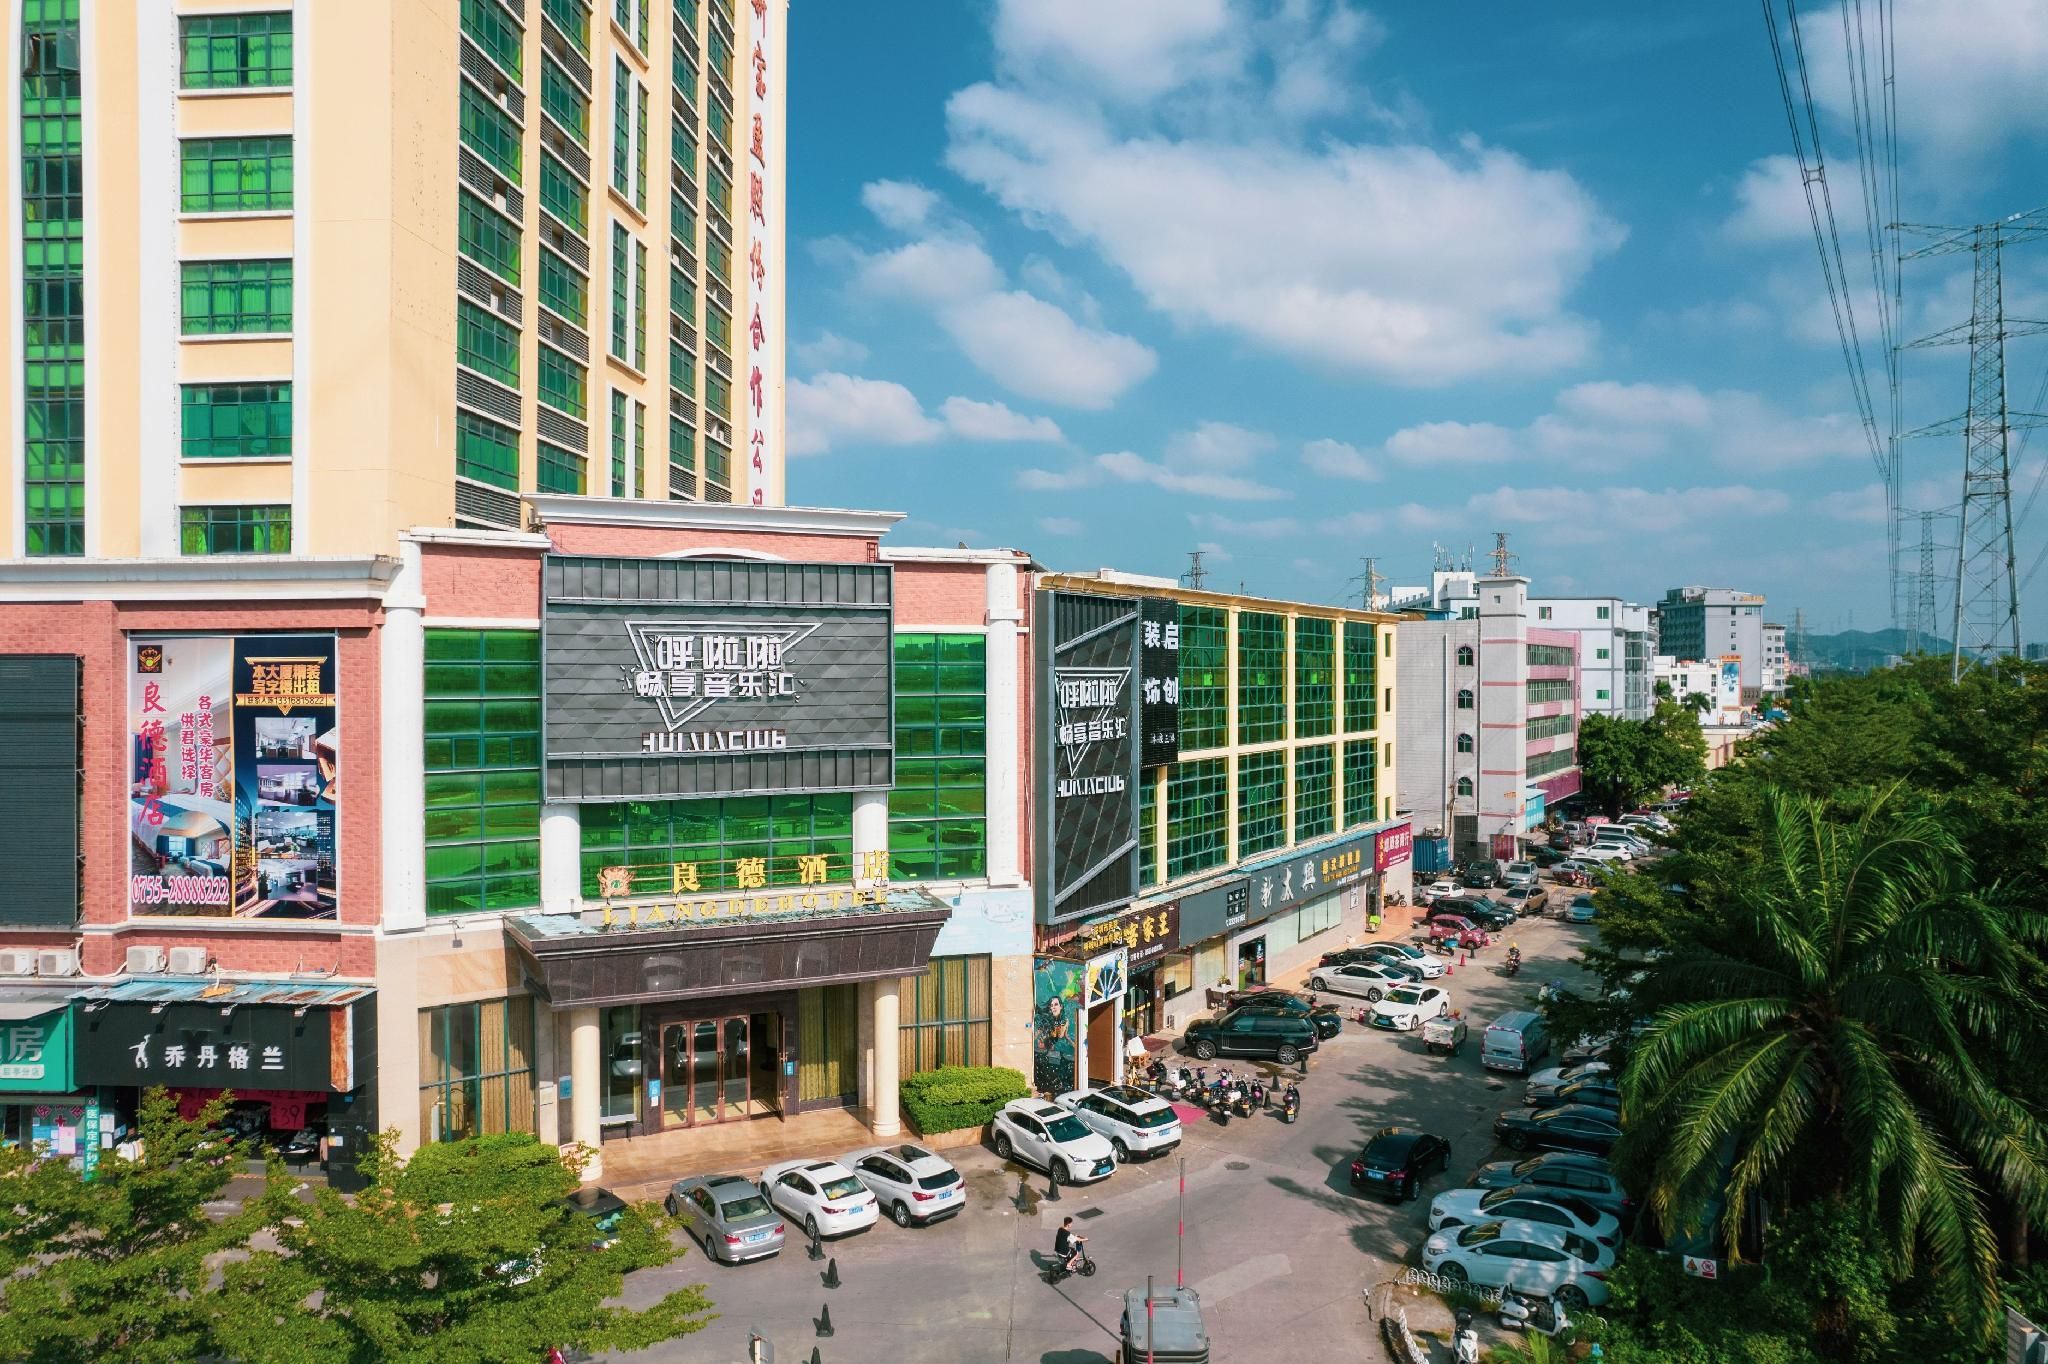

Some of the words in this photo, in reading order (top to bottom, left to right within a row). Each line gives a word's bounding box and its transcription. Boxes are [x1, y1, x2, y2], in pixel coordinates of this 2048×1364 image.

[139, 681, 168, 825] 良德酒店
[132, 875, 229, 904] 0755-28888222
[672, 850, 890, 895] 良德酒店
[0, 1026, 45, 1062] 房
[164, 1045, 285, 1070] 乔丹格兰
